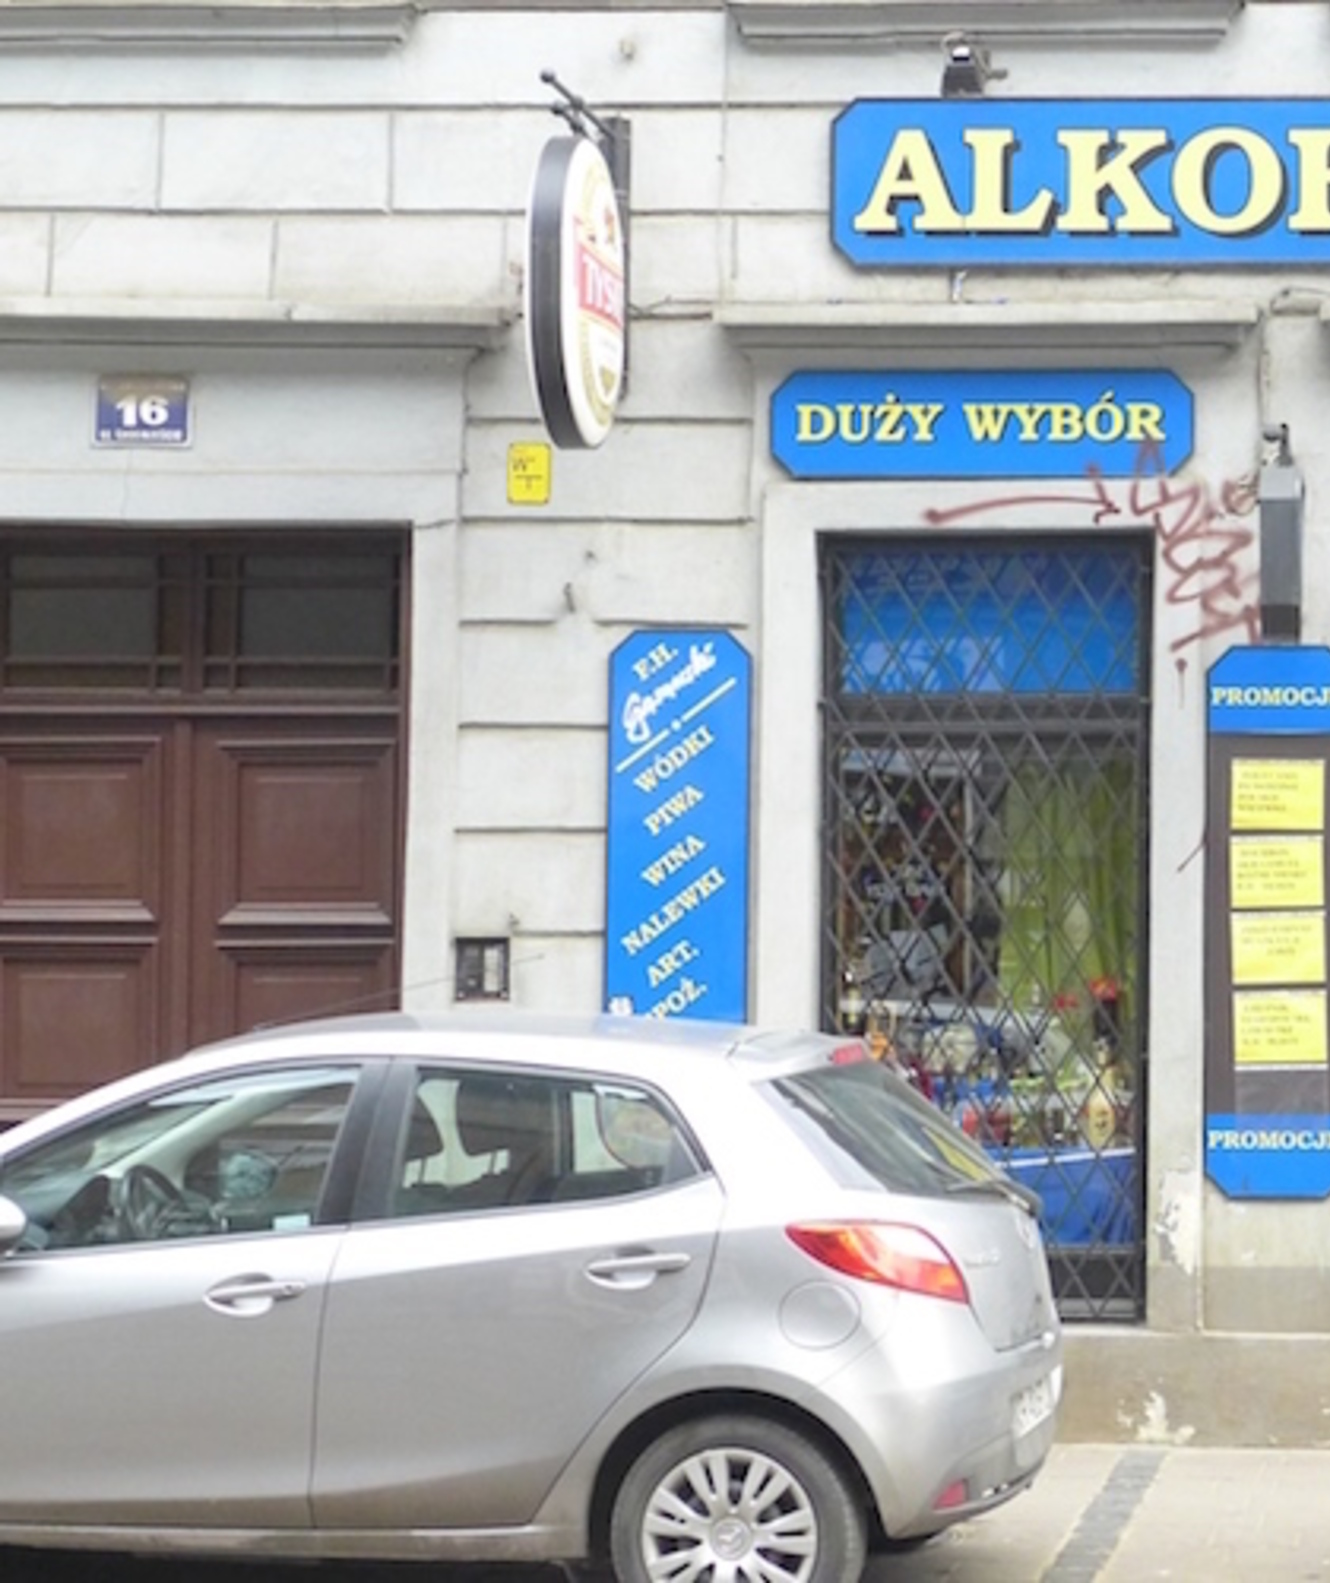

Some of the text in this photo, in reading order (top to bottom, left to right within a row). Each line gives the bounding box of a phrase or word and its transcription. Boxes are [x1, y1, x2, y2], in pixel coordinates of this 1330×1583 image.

[116, 395, 169, 428] 16
[795, 390, 1167, 447] DUŻY WYBÓR
[632, 724, 715, 793] WÓDKI
[642, 783, 705, 837] PIWA
[640, 834, 707, 887] WINA
[620, 865, 727, 957] NALEWKI
[647, 938, 701, 988] ART.
